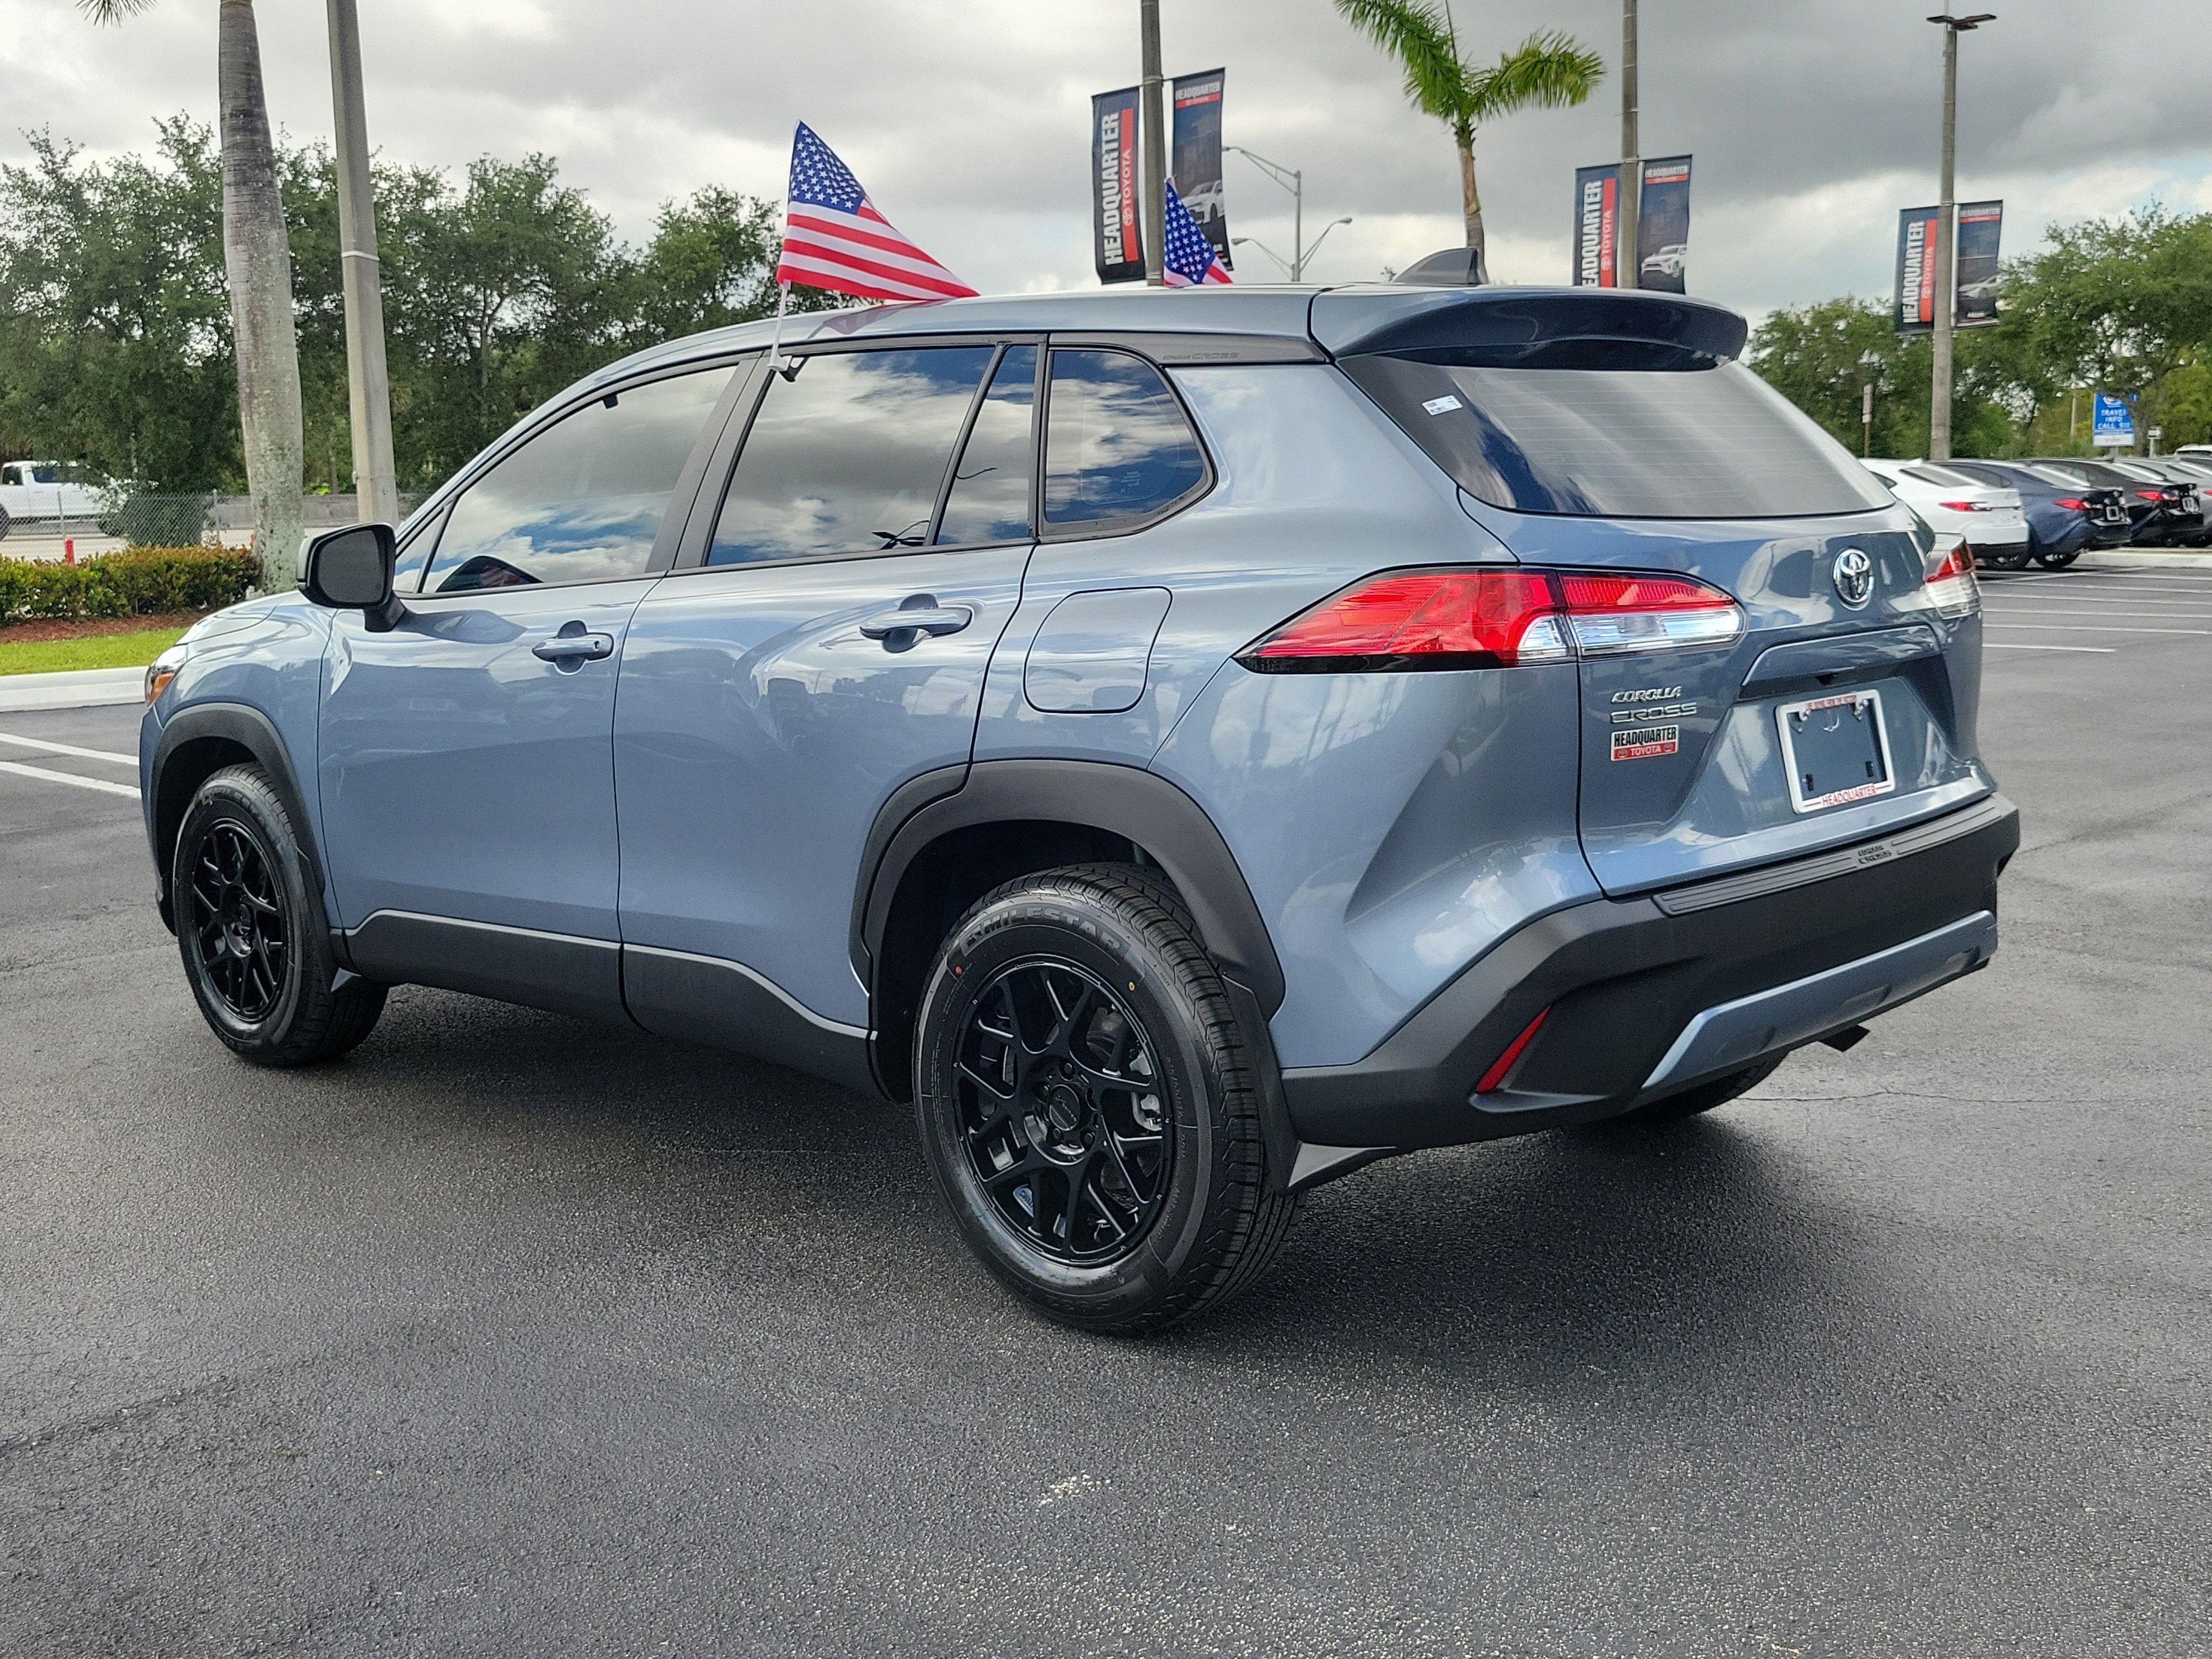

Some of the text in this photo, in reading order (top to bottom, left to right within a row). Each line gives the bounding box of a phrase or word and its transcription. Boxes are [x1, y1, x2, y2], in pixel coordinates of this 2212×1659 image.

[1102, 111, 1124, 265] HEADQUARTER
[1121, 149, 1132, 204] TOYOTA
[1582, 180, 1602, 287] EADQUARTER
[1902, 221, 1925, 323] HEADQUARTER
[1611, 686, 1682, 703] COROLLA
[1611, 702, 1697, 723] CROSS
[1614, 727, 1677, 747] HEADQUARTER
[1630, 746, 1661, 756] TOYOTA
[1822, 785, 1876, 805] HEADQUARTER
[983, 907, 1121, 950] MILESTAR
